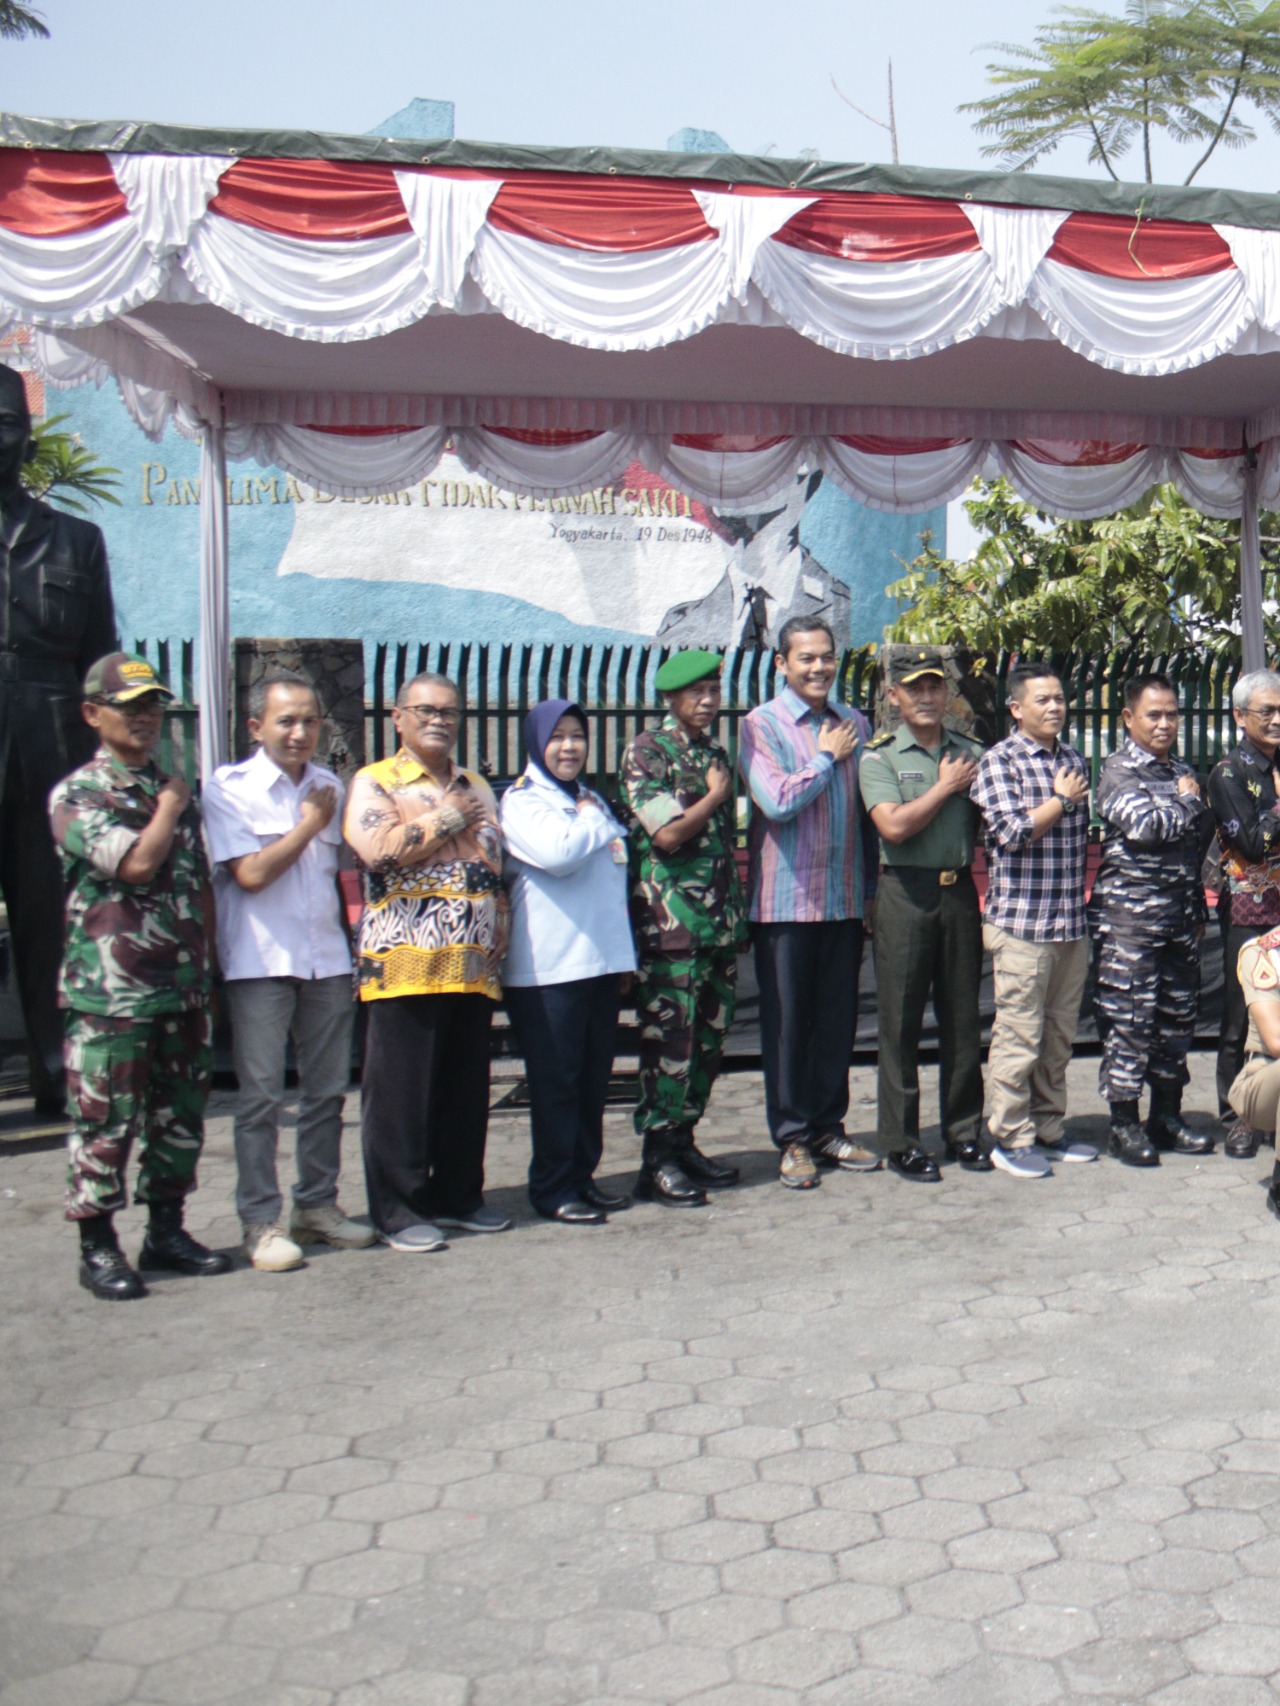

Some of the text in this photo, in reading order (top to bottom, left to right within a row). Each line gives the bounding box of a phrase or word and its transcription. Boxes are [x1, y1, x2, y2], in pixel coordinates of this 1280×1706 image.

[141, 462, 305, 506] PANLIMA
[634, 526, 652, 541] 19
[657, 527, 680, 542] Des
[681, 527, 713, 543] 1948
